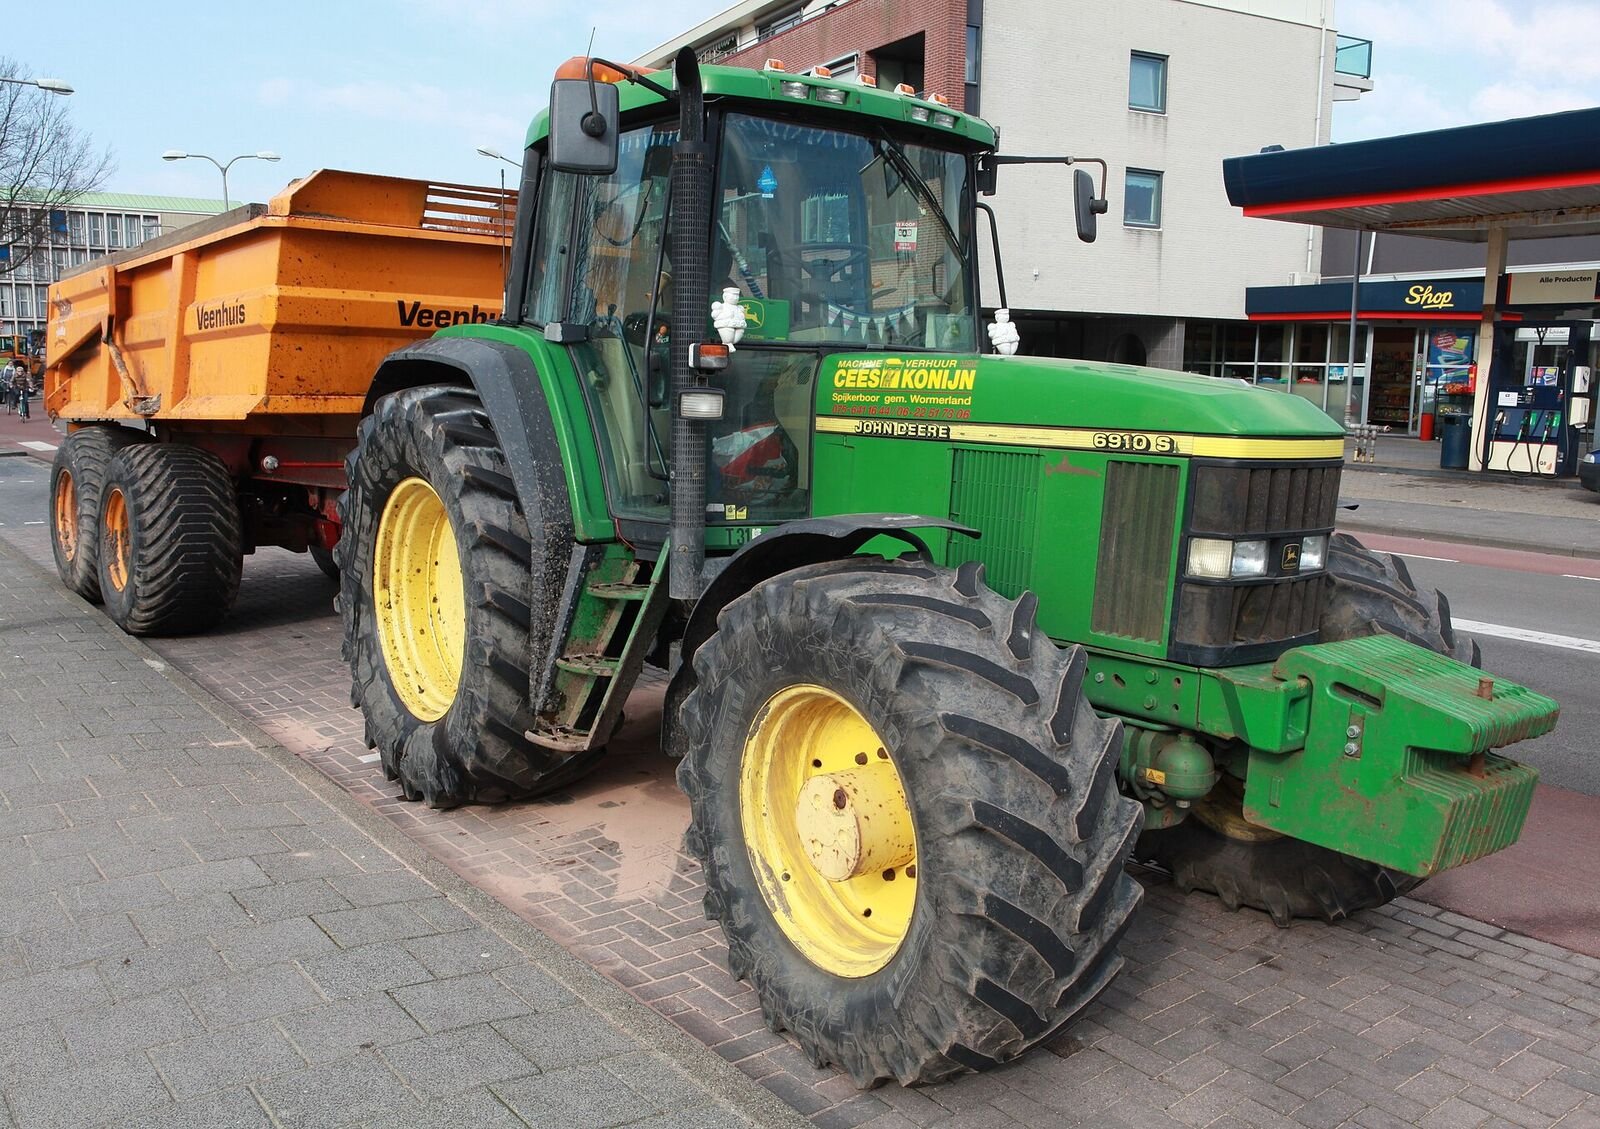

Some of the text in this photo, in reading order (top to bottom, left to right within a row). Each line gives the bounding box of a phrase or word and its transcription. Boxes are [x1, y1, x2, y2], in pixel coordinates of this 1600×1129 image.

[1554, 275, 1592, 283] Producten
[1405, 285, 1454, 309] Shop
[197, 298, 245, 330] Veenhuis
[397, 300, 503, 328] Veenh
[838, 359, 883, 368] MACHINE
[904, 360, 957, 368] VERHUUR
[834, 369, 976, 390] CEES KONIJN
[832, 393, 972, 406] Spijkerboor gem. Wormerland
[855, 421, 949, 438] JOHN DEERE
[1093, 432, 1172, 452] 6910 S
